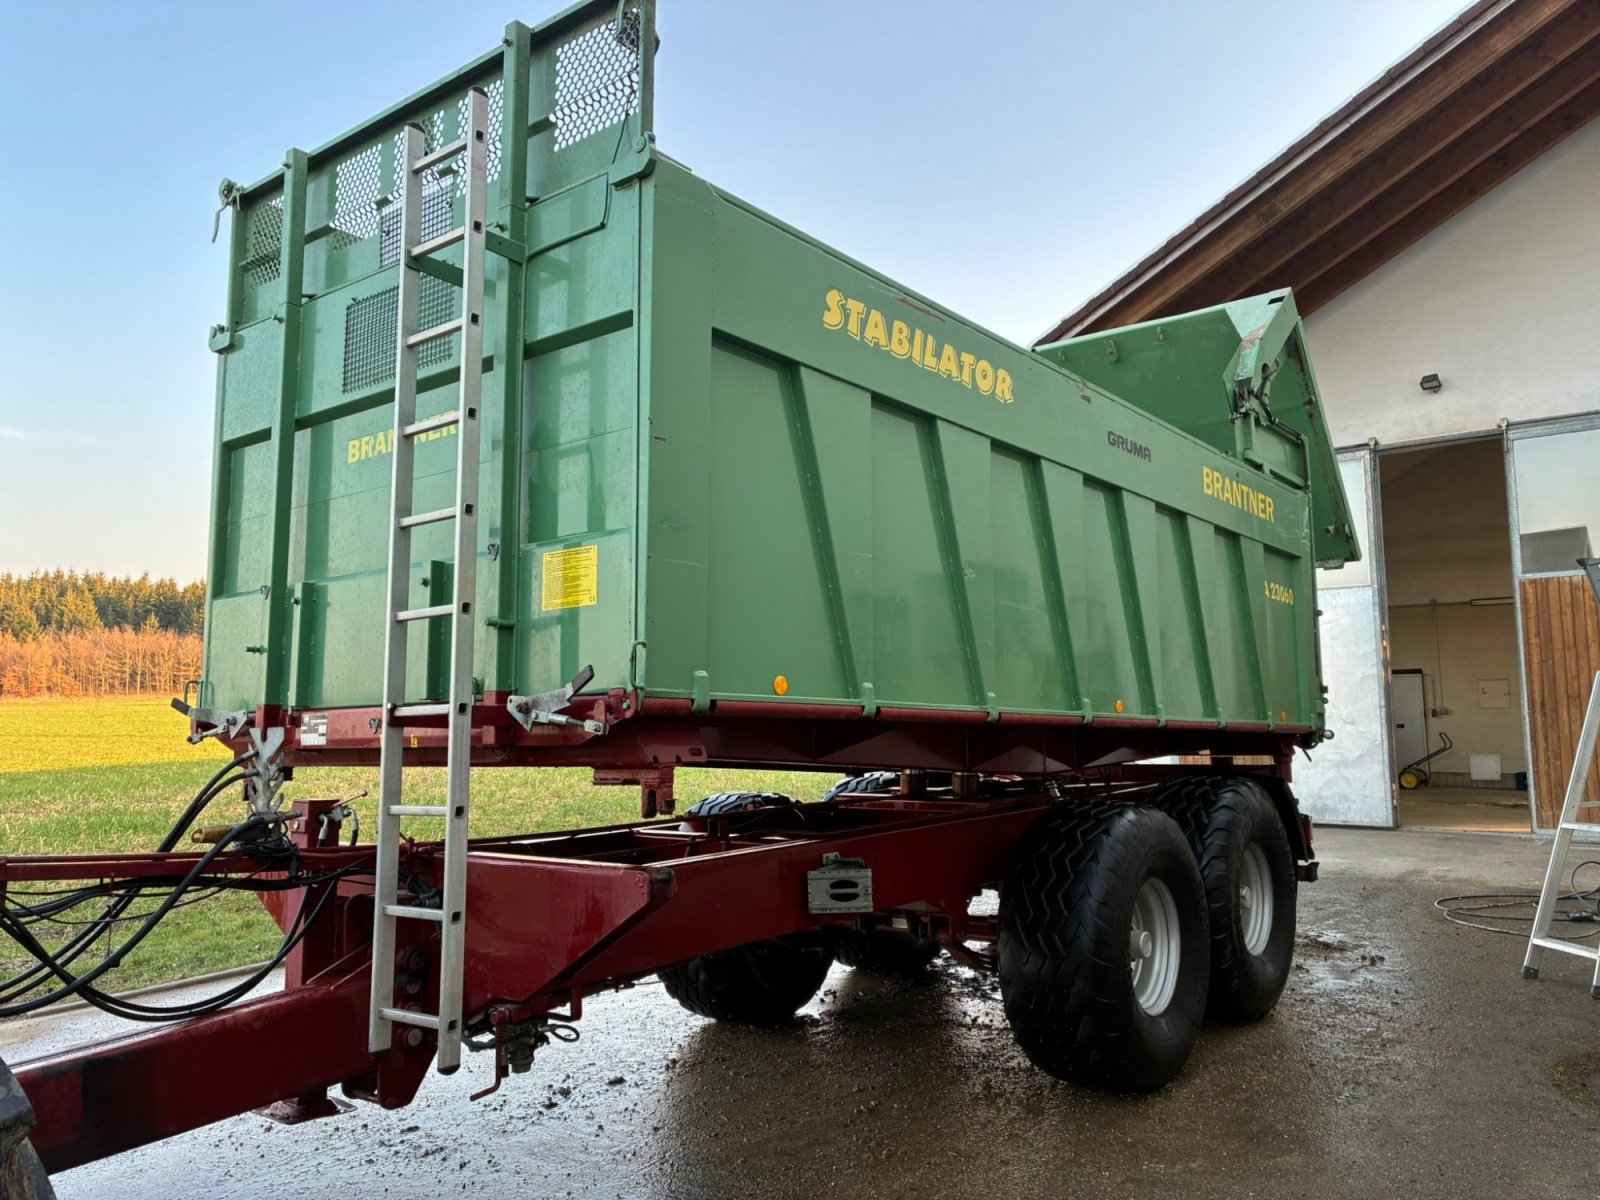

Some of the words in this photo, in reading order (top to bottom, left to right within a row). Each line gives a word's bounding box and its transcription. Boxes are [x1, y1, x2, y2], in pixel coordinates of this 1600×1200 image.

[822, 289, 1014, 404] STABILATOR
[347, 410, 457, 464] BRANNER
[1107, 431, 1152, 462] GRUMA
[1202, 465, 1275, 522] BRANTNER
[1270, 582, 1294, 605] 23060
